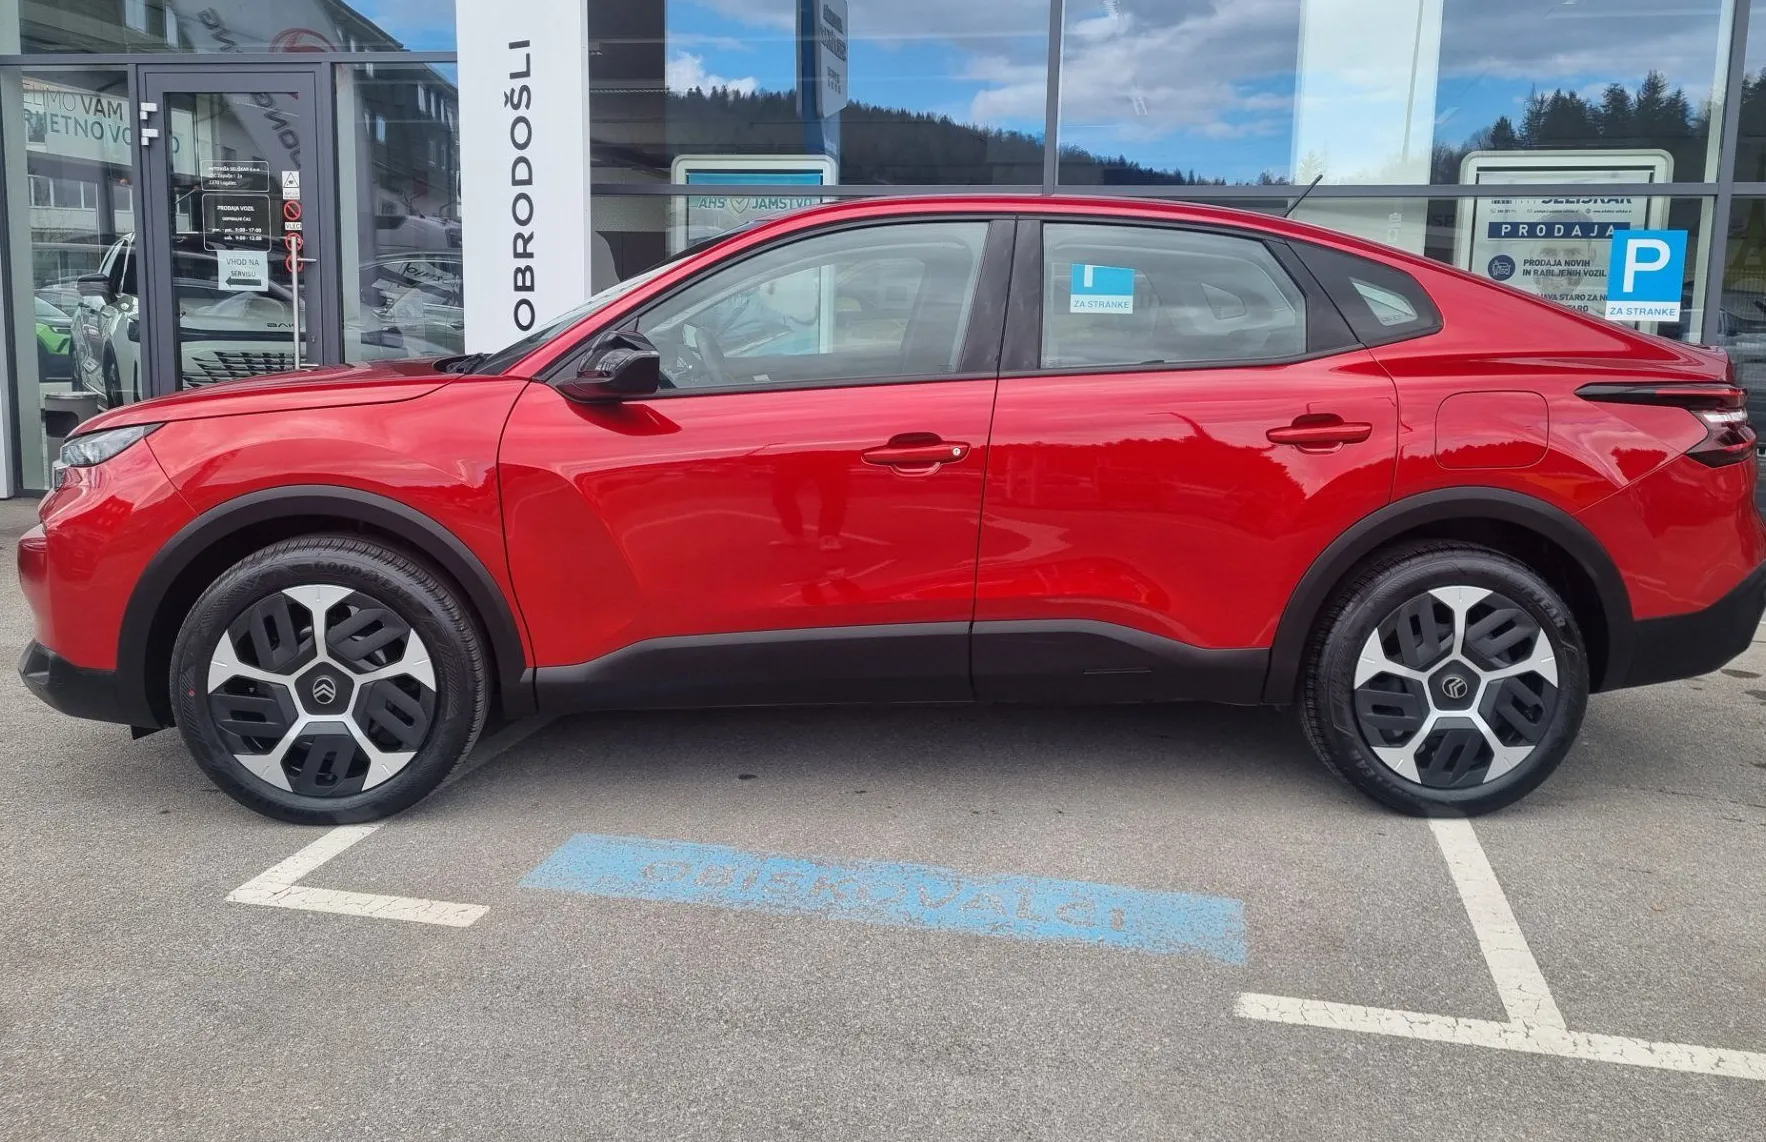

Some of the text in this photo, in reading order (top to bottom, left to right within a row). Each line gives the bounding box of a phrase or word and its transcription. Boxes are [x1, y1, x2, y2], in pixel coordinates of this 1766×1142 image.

[80, 94, 124, 121] VAM
[698, 198, 813, 210] AHS JAMSTVO
[1501, 224, 1615, 237] PRODAJA
[226, 258, 260, 266] VHOD NA
[1523, 259, 1591, 267] PRODAJA NOVIH
[1623, 238, 1671, 293] P
[1522, 268, 1607, 277] IN RABLJENIH VOZIL
[1074, 300, 1130, 309] ZA STRANKE
[1610, 307, 1676, 316] ZA STRANKE
